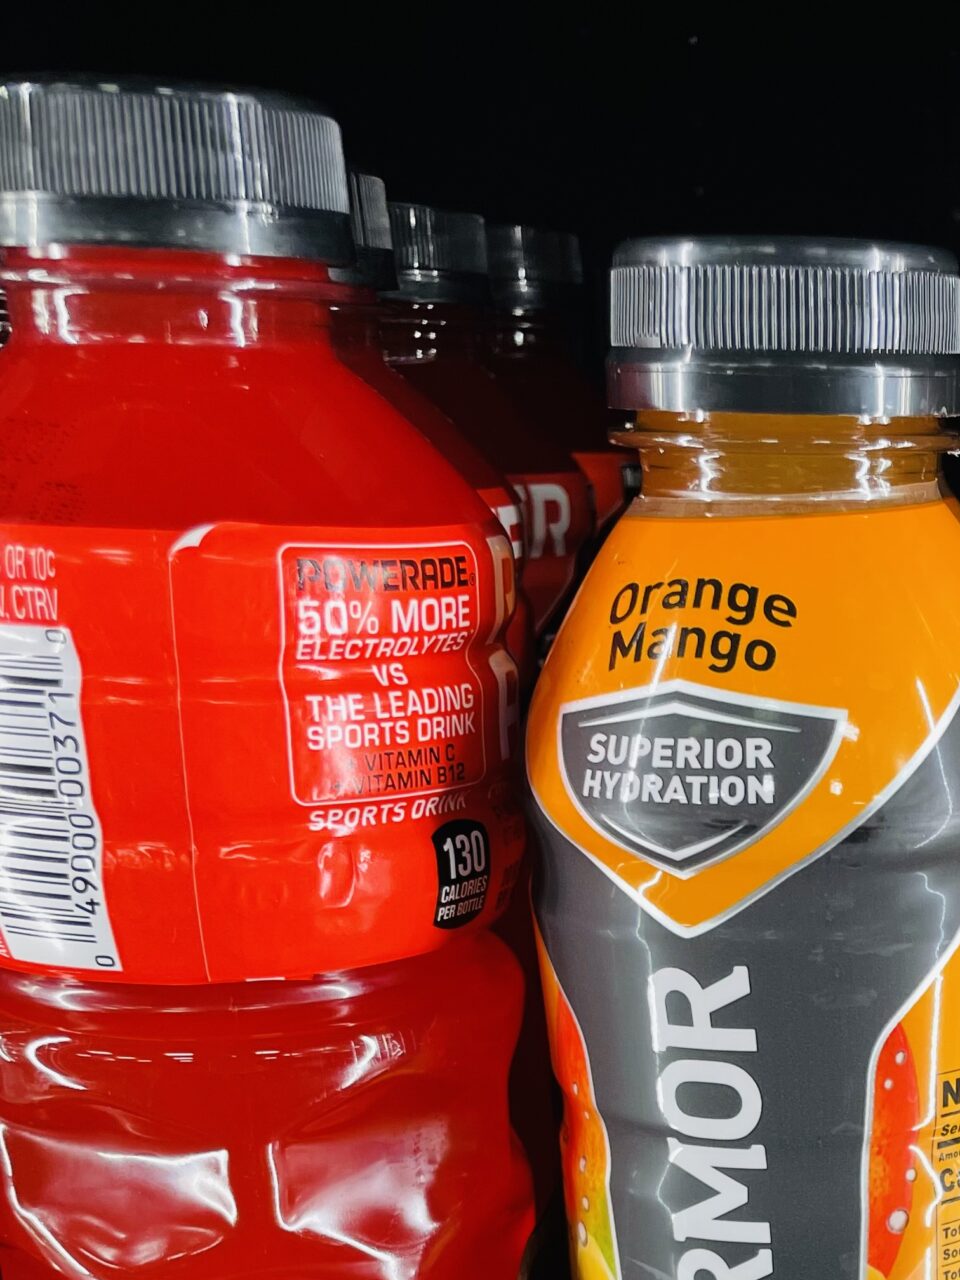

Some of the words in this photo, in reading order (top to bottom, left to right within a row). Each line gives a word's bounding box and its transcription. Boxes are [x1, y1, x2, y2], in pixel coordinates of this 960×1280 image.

[5, 547, 27, 580] OR
[12, 588, 58, 622] CTRV
[298, 598, 380, 636] 50%
[391, 594, 471, 634] MORE
[610, 577, 798, 628] Orange
[606, 622, 778, 673] Mango
[372, 663, 409, 687] VS
[305, 694, 365, 723] THE
[374, 683, 475, 719] LEADING
[307, 721, 408, 751] SPORTS
[418, 712, 476, 742] DRINK
[365, 746, 441, 771] VITAMIN
[445, 744, 456, 762] C
[587, 732, 775, 769] SUPERIOR
[352, 768, 432, 795] VITAMIN
[437, 763, 466, 785] B12
[582, 769, 775, 805] HYDRATION
[308, 801, 405, 832] SPORTS
[411, 790, 471, 820] DRINK
[443, 830, 487, 880] 130
[440, 875, 488, 904] CALORIES
[437, 906, 456, 922] PER
[457, 895, 486, 915] BOTTLE
